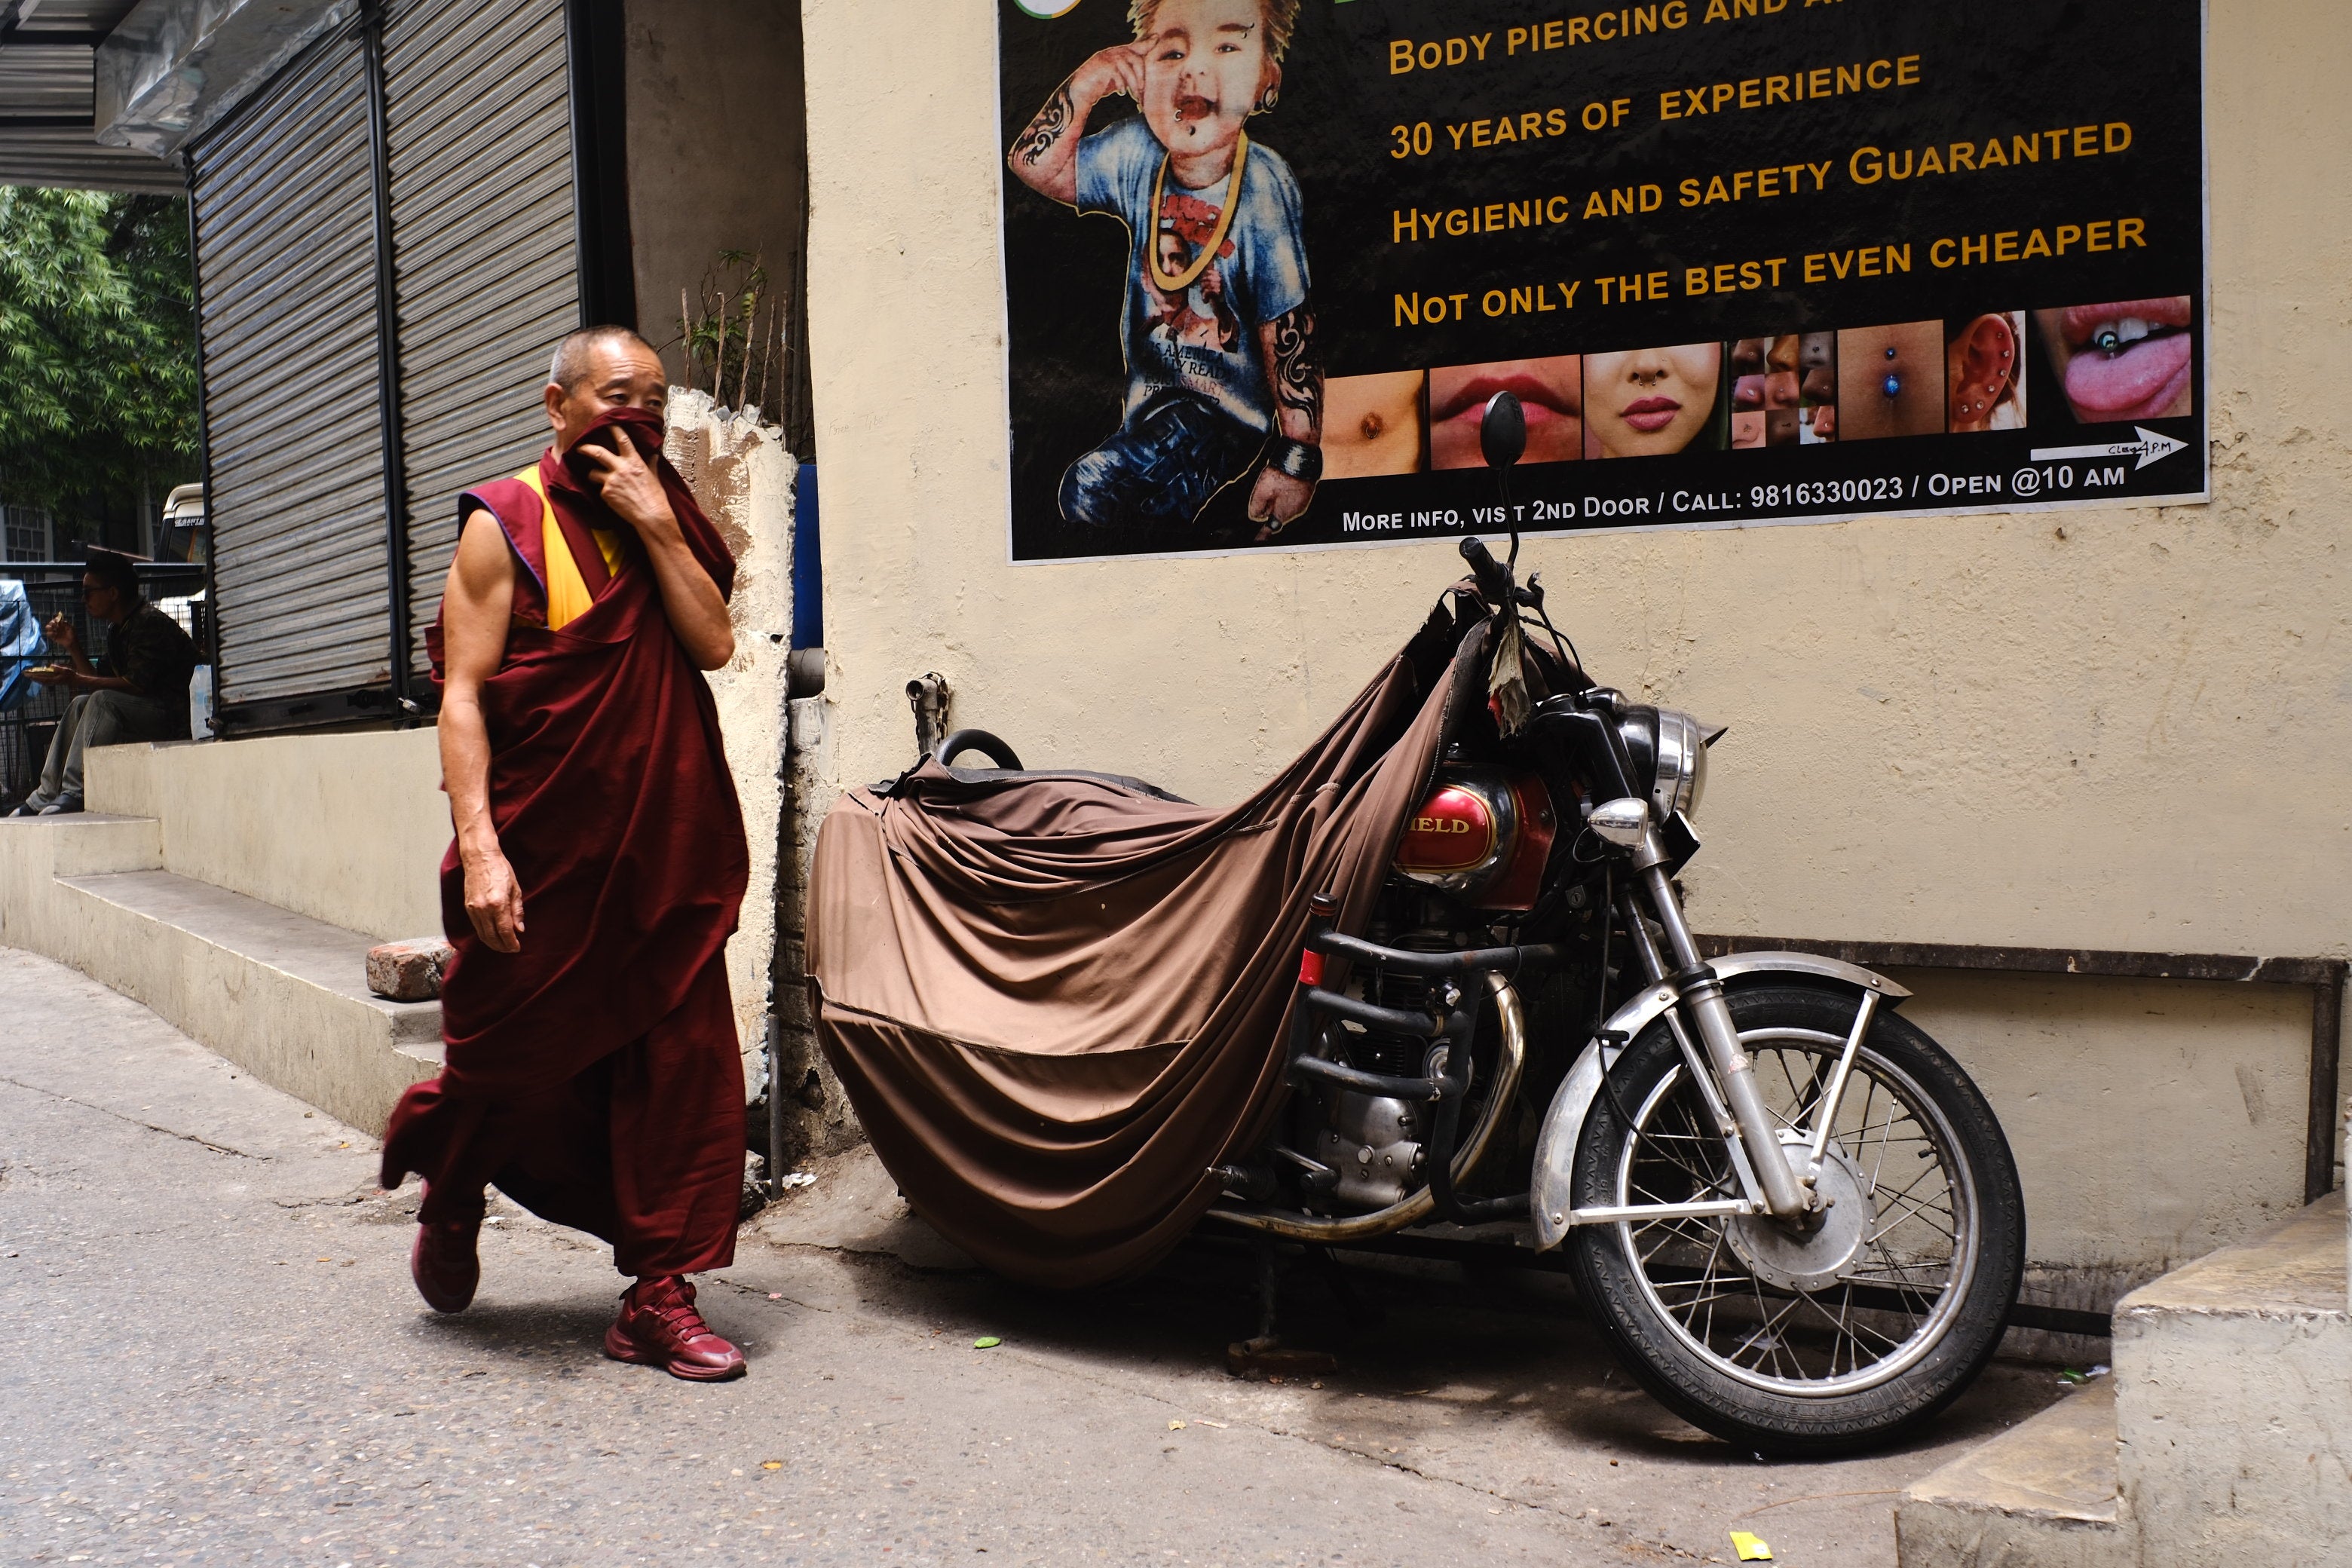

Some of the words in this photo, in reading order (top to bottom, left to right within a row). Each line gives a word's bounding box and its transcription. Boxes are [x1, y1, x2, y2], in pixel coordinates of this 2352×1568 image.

[1389, 32, 1493, 75] BODY
[1507, 0, 1688, 56] PIERCING
[1390, 121, 1433, 159] 30
[1447, 108, 1566, 150] YEARS
[1582, 98, 1631, 131] OF
[1660, 54, 1920, 121] EXPERIENCE
[1393, 195, 1569, 243] HYGIENIC
[1582, 184, 1662, 219] AND
[1679, 161, 1833, 207] SAFETY
[1849, 121, 2132, 185] GUARANTED
[1394, 292, 1468, 327] NOT
[1482, 280, 1581, 317] ONLY
[1594, 271, 1669, 305] THE
[1686, 258, 1787, 296] BEST
[1804, 243, 1911, 283] EVEN
[1930, 218, 2147, 268] CHEAPER
[1343, 511, 1403, 532] MORE
[1410, 510, 1465, 529] INFO,
[1472, 505, 1525, 524] VIST
[1533, 500, 1576, 520] 2ND
[1584, 496, 1650, 517] DOOR
[1657, 492, 1664, 513] /
[1672, 490, 1741, 512] CALL:
[1750, 476, 1903, 508] 9816330023
[1911, 475, 1919, 498] /
[1928, 473, 2001, 496] OPEN
[2011, 465, 2074, 497] @10
[2084, 467, 2124, 487] AM
[1410, 817, 1470, 834] IELD
